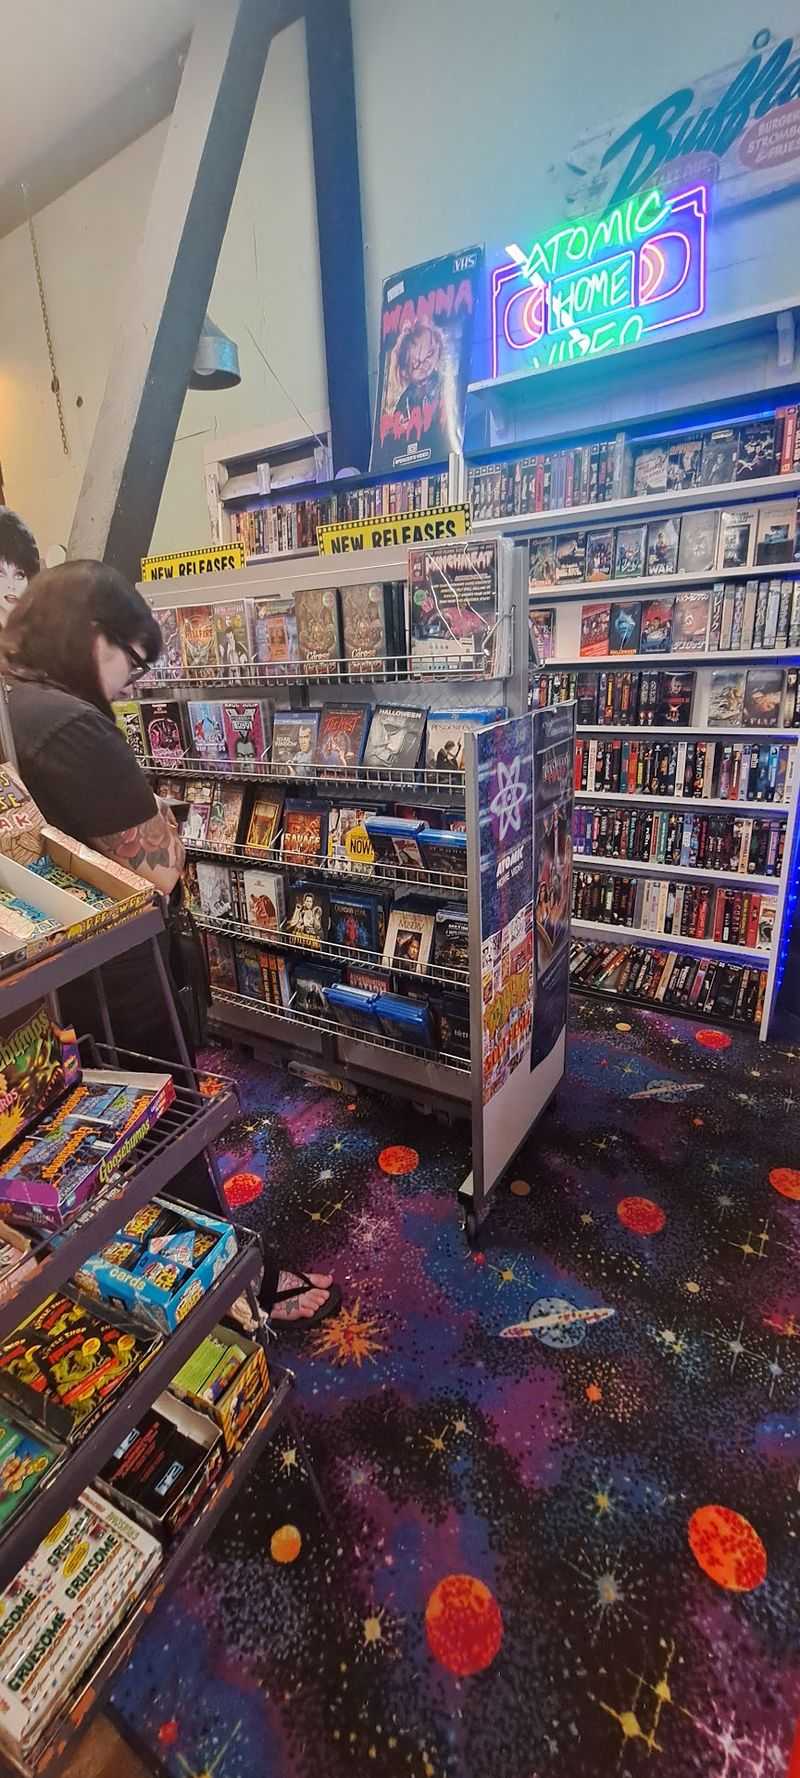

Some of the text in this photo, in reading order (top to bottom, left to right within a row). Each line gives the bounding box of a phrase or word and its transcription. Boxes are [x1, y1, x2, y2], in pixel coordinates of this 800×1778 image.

[524, 189, 671, 277] ATOMIC
[452, 254, 476, 272] VHS
[382, 279, 474, 342] WANNA
[555, 259, 631, 328] HOME
[331, 519, 457, 555] NEW RELEASES
[151, 555, 235, 581] NEW RELEASES
[378, 708, 422, 720] HALLOWEEN
[284, 833, 321, 845] SAVAGE
[496, 845, 525, 878] ATOMIC
[99, 1118, 151, 1184] Goosebumps
[110, 1267, 146, 1292] cards
[64, 1533, 118, 1600] GRUESOME
[7, 1611, 66, 1692] GRUESOME
